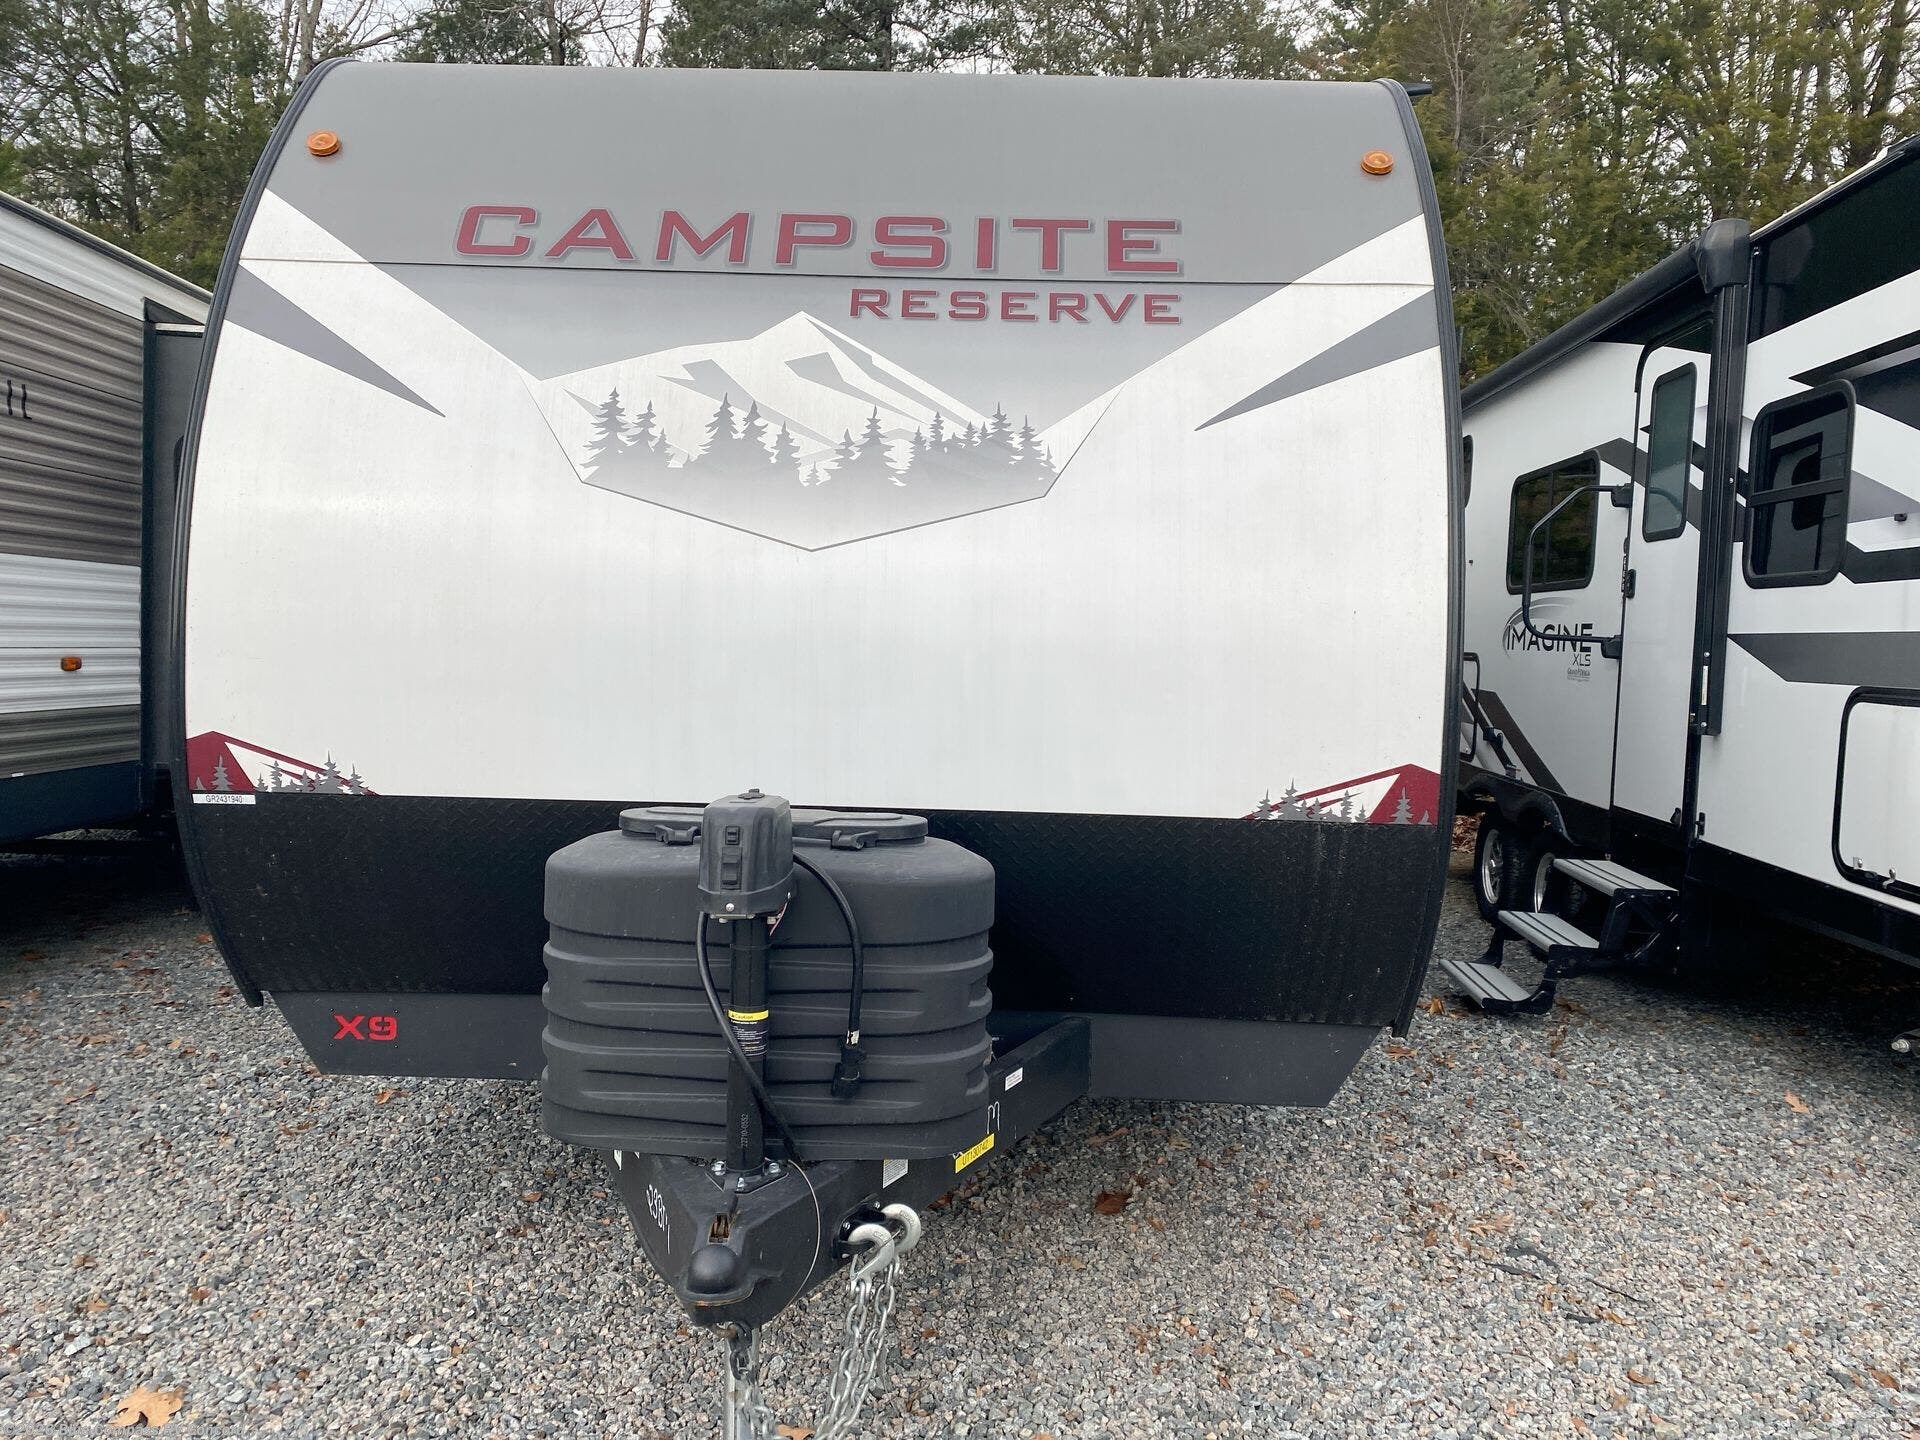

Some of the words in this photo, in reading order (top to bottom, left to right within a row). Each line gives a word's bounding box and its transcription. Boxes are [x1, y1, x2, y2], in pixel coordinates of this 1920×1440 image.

[453, 204, 1183, 274] CAMPSITE
[849, 287, 1182, 325] RESERVE
[1506, 623, 1593, 653] IMAGINE
[1572, 653, 1591, 667] XLS
[332, 1014, 398, 1041] X9
